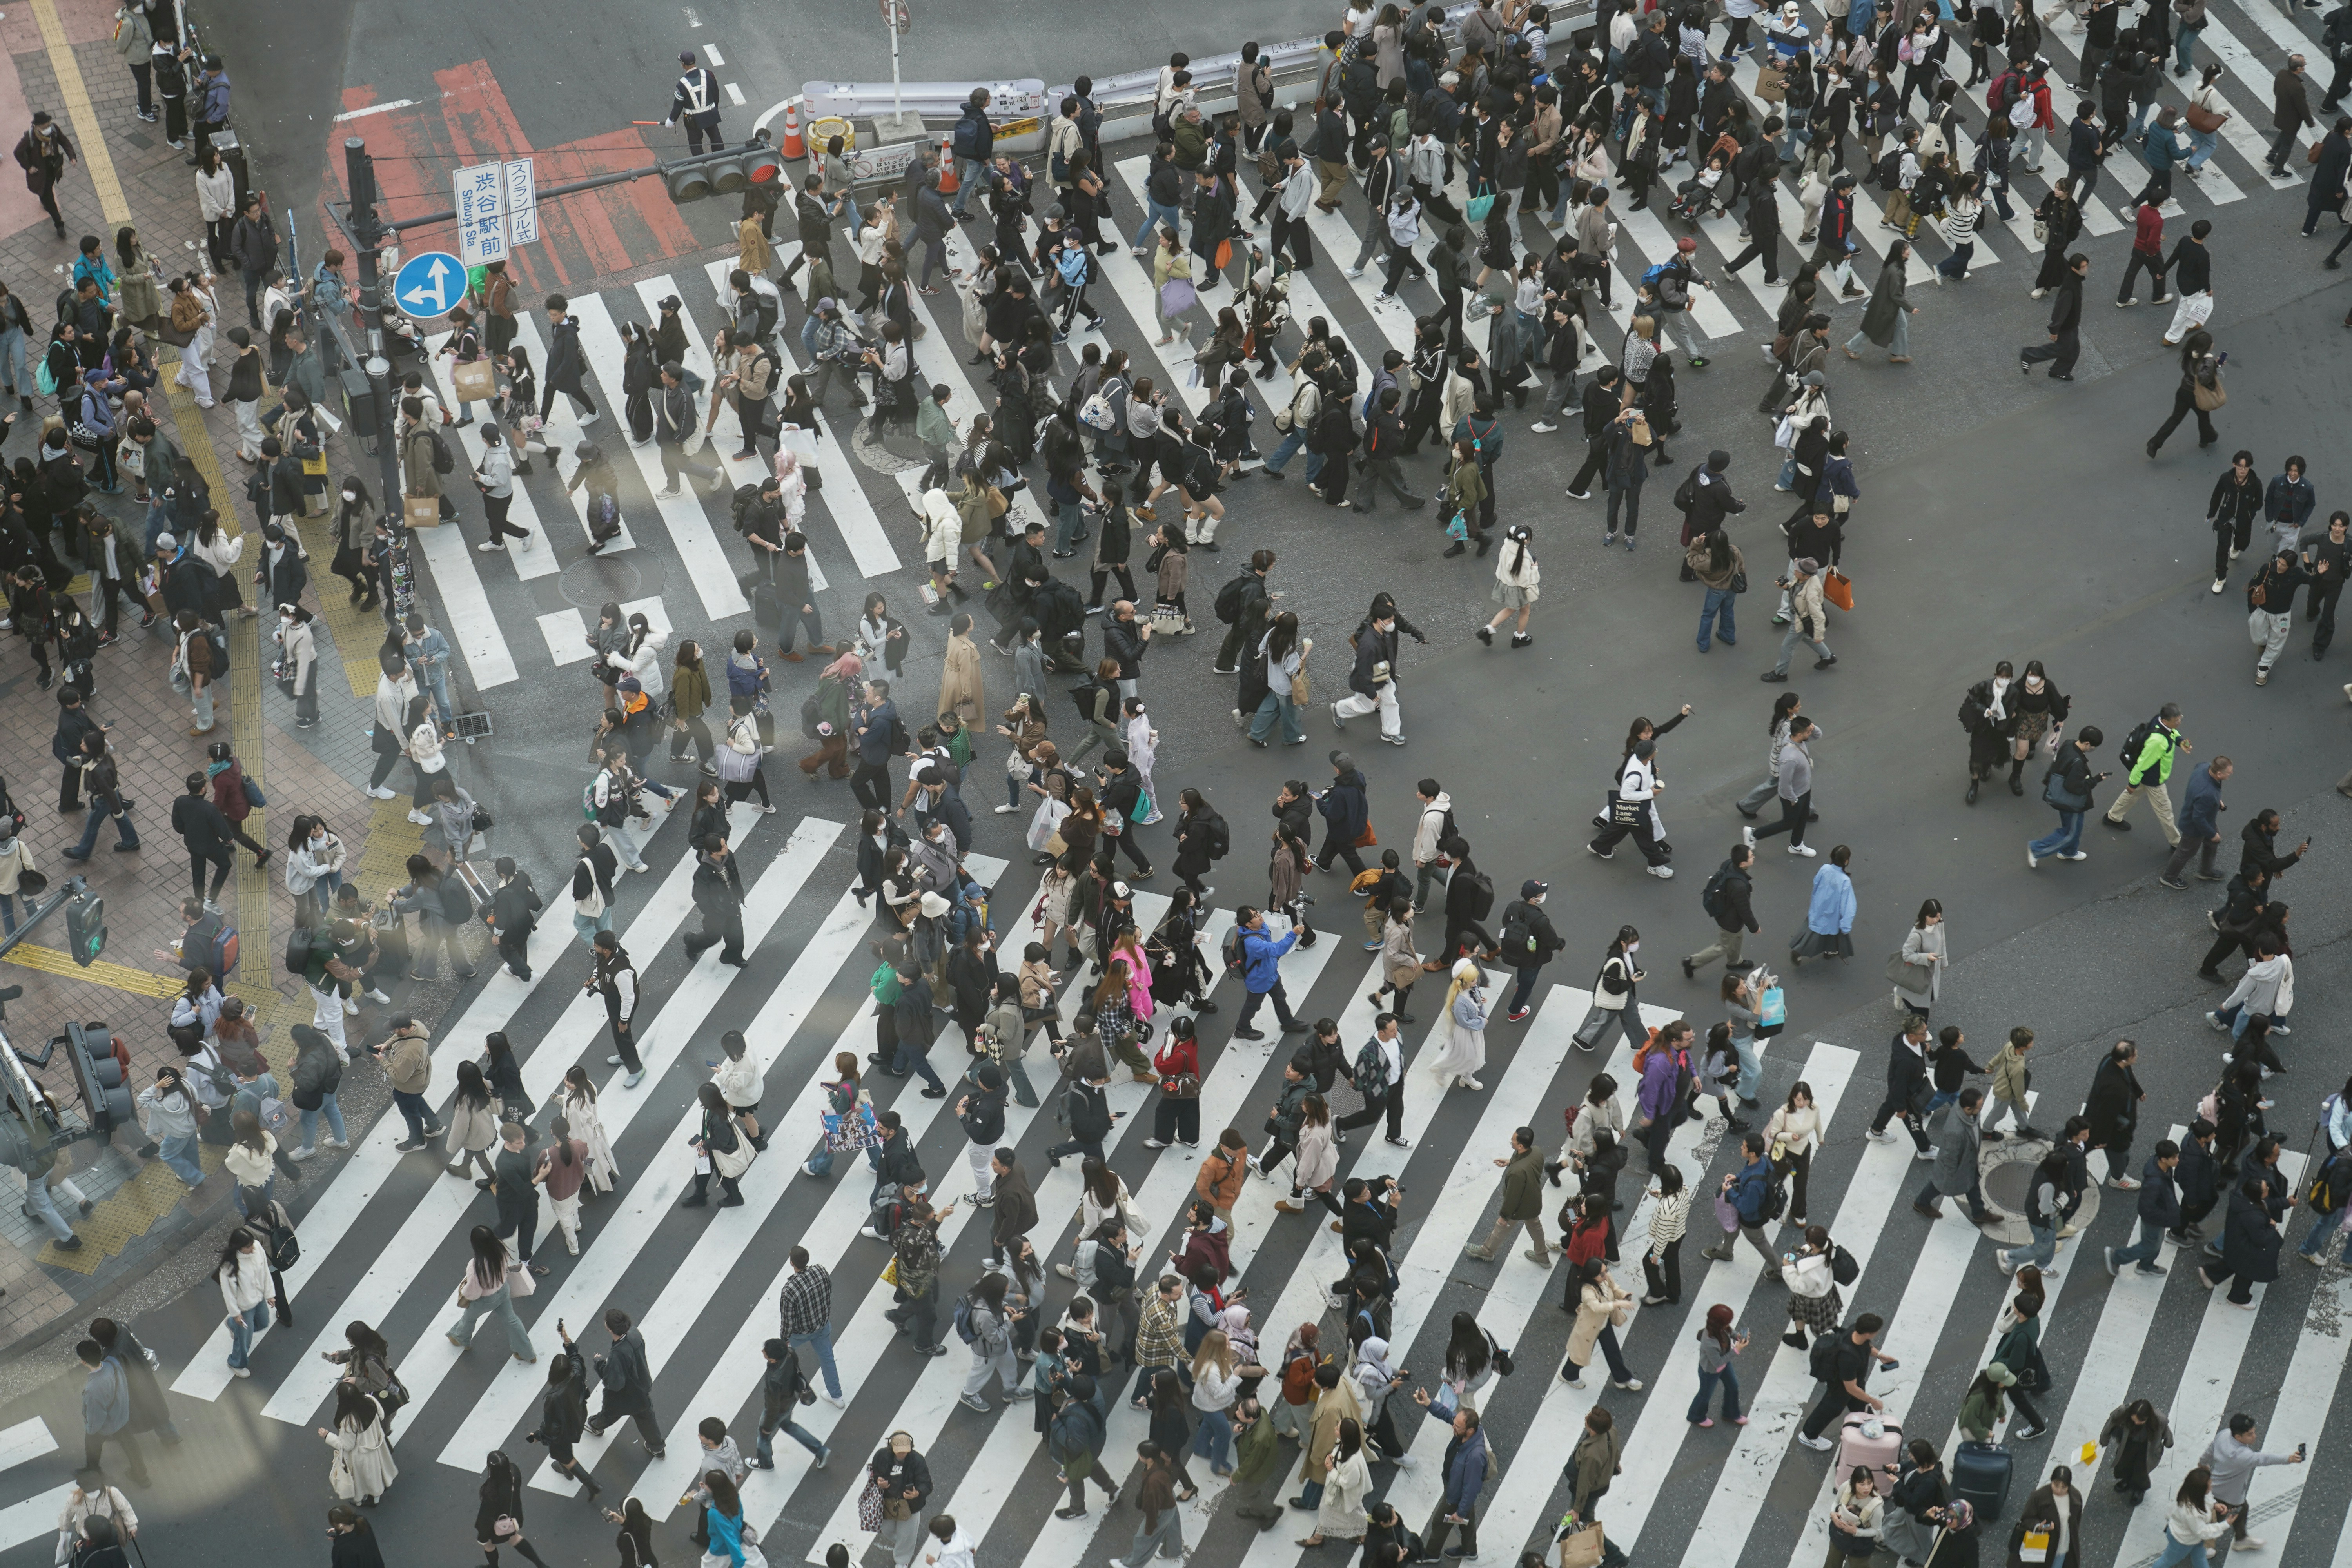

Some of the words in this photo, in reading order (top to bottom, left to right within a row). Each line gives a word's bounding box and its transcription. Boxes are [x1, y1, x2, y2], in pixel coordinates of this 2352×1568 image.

[877, 156, 911, 167] はいっては
[461, 189, 474, 228] Shibuya
[475, 172, 501, 256] 渋谷駅前
[511, 164, 531, 240] スクランブル式
[464, 230, 476, 250] Sta.
